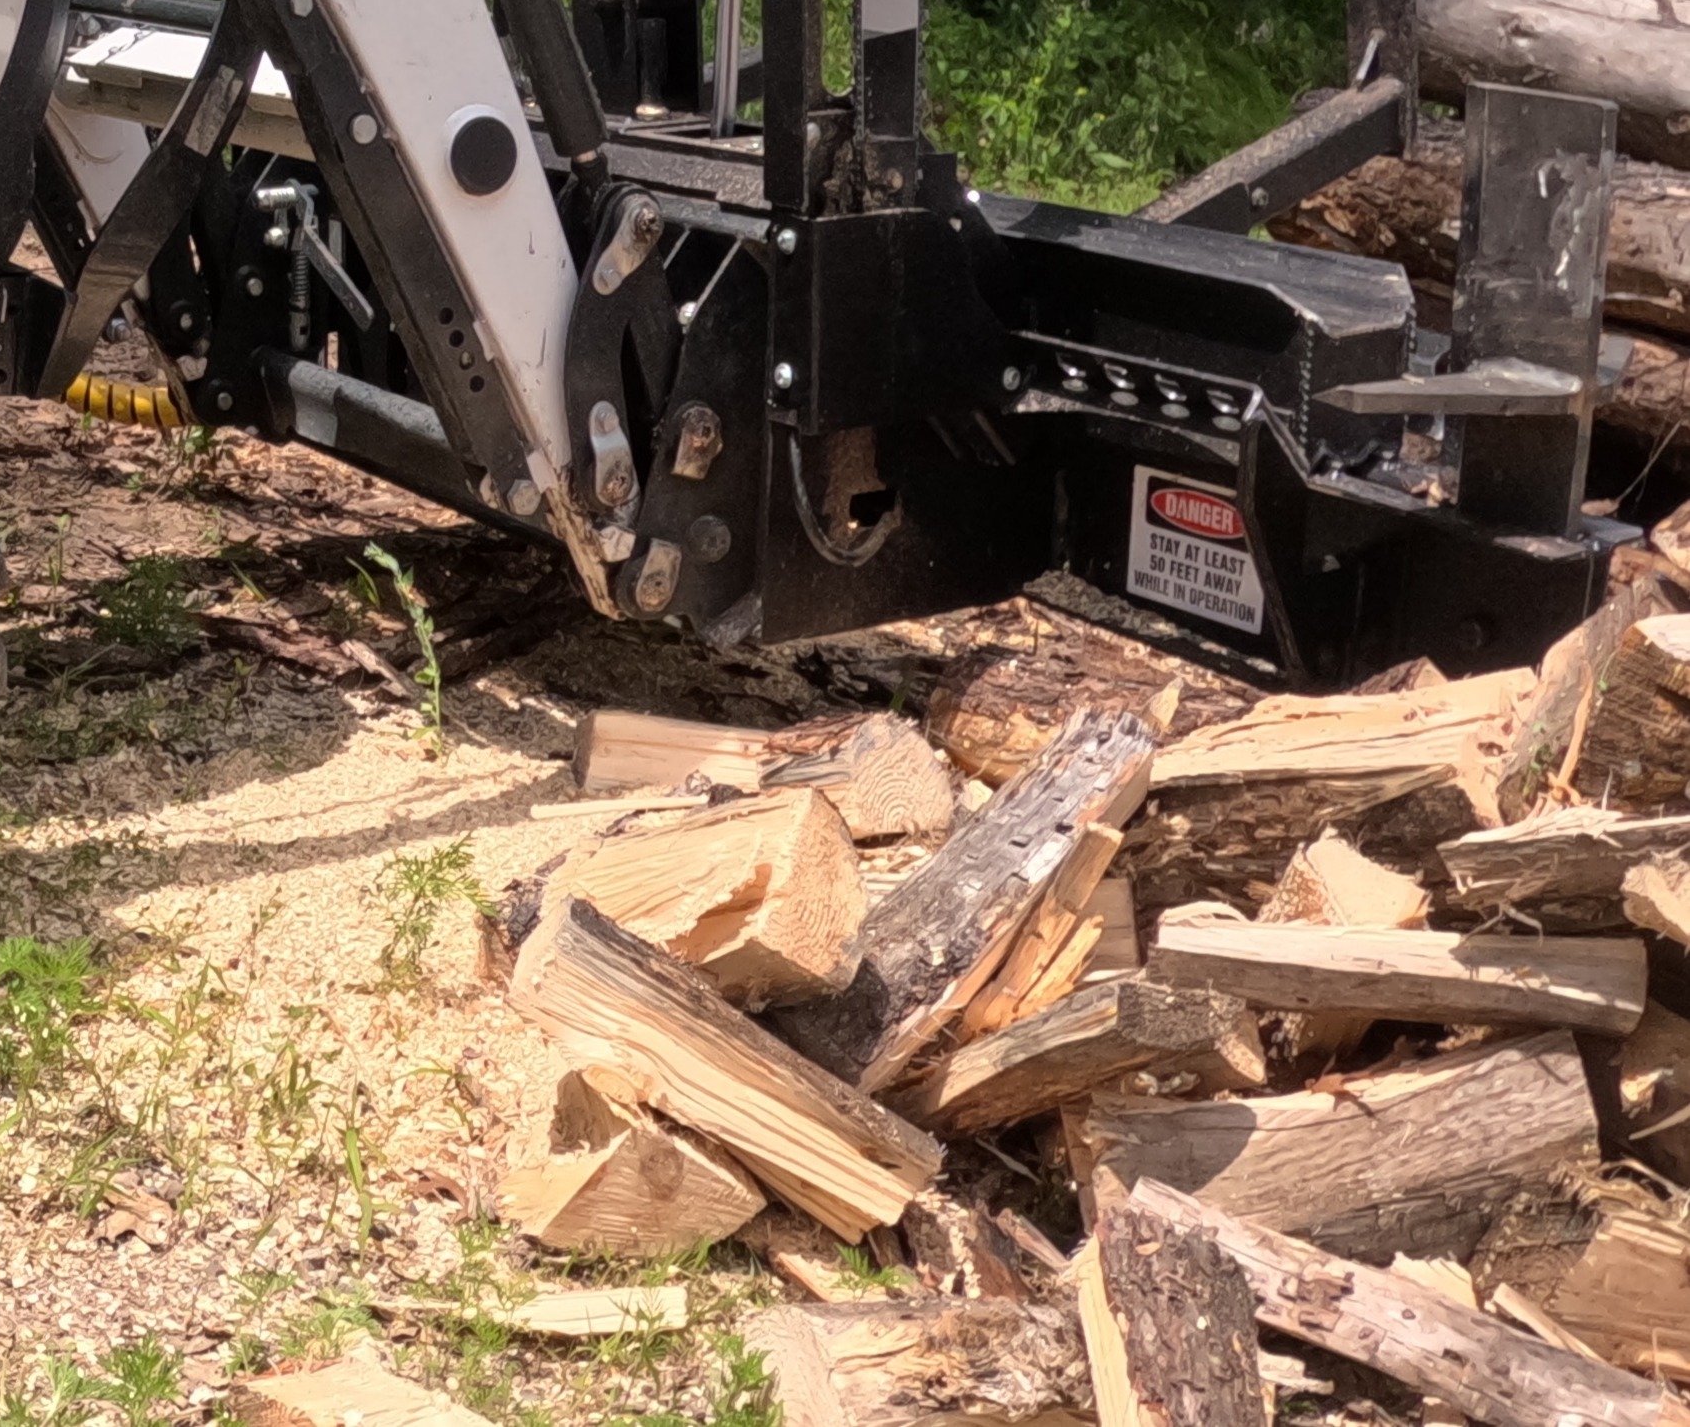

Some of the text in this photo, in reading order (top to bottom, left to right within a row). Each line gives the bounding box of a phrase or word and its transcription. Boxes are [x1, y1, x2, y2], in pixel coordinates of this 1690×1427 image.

[1165, 493, 1234, 533] DANGER
[1149, 555, 1242, 598] 50 FEET AWAY
[1150, 532, 1246, 577] STAY AT LEAST
[1134, 570, 1256, 624] WHILE IN OPERATION
